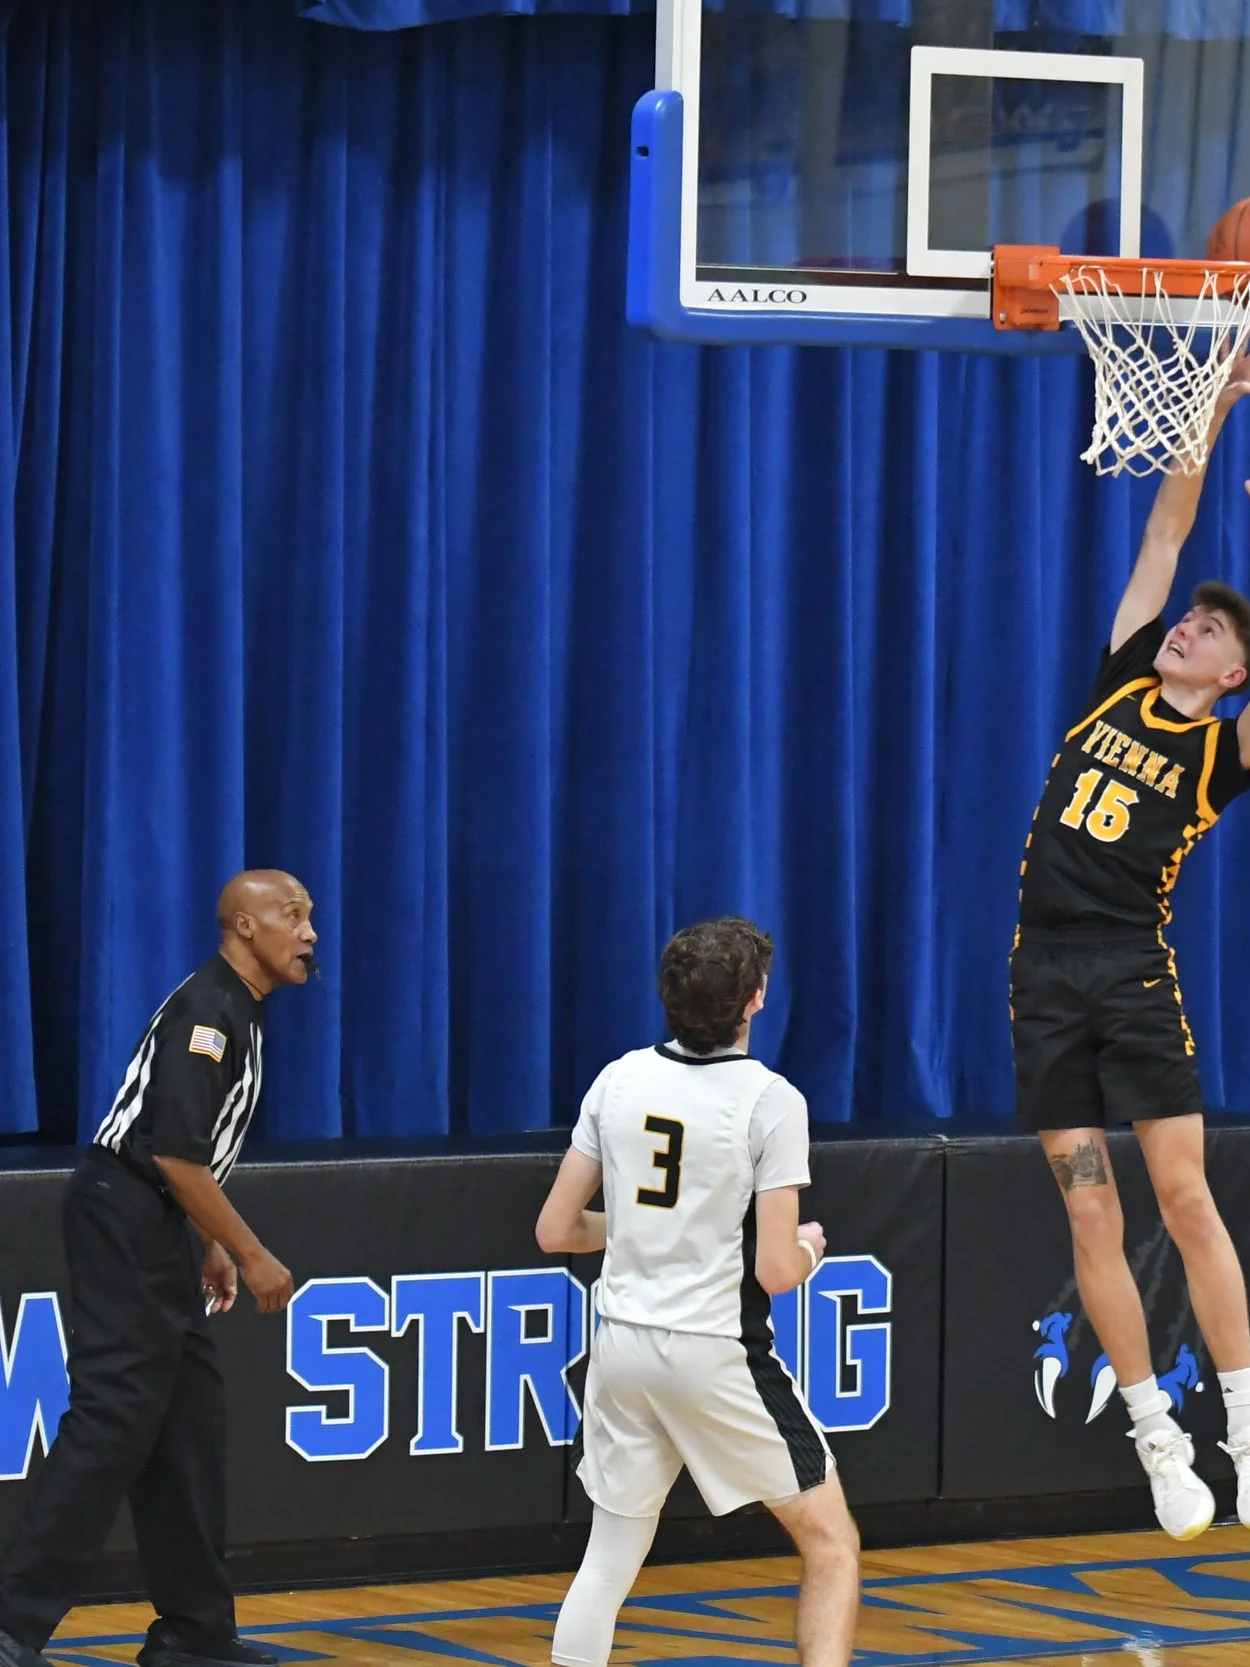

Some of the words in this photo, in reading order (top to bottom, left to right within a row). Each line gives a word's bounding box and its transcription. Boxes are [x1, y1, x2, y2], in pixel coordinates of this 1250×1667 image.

[707, 288, 808, 304] AALCO
[1081, 719, 1185, 799] VIENNA
[1060, 768, 1139, 842] 15
[636, 1113, 685, 1210] 3
[285, 1255, 893, 1462] STRG
